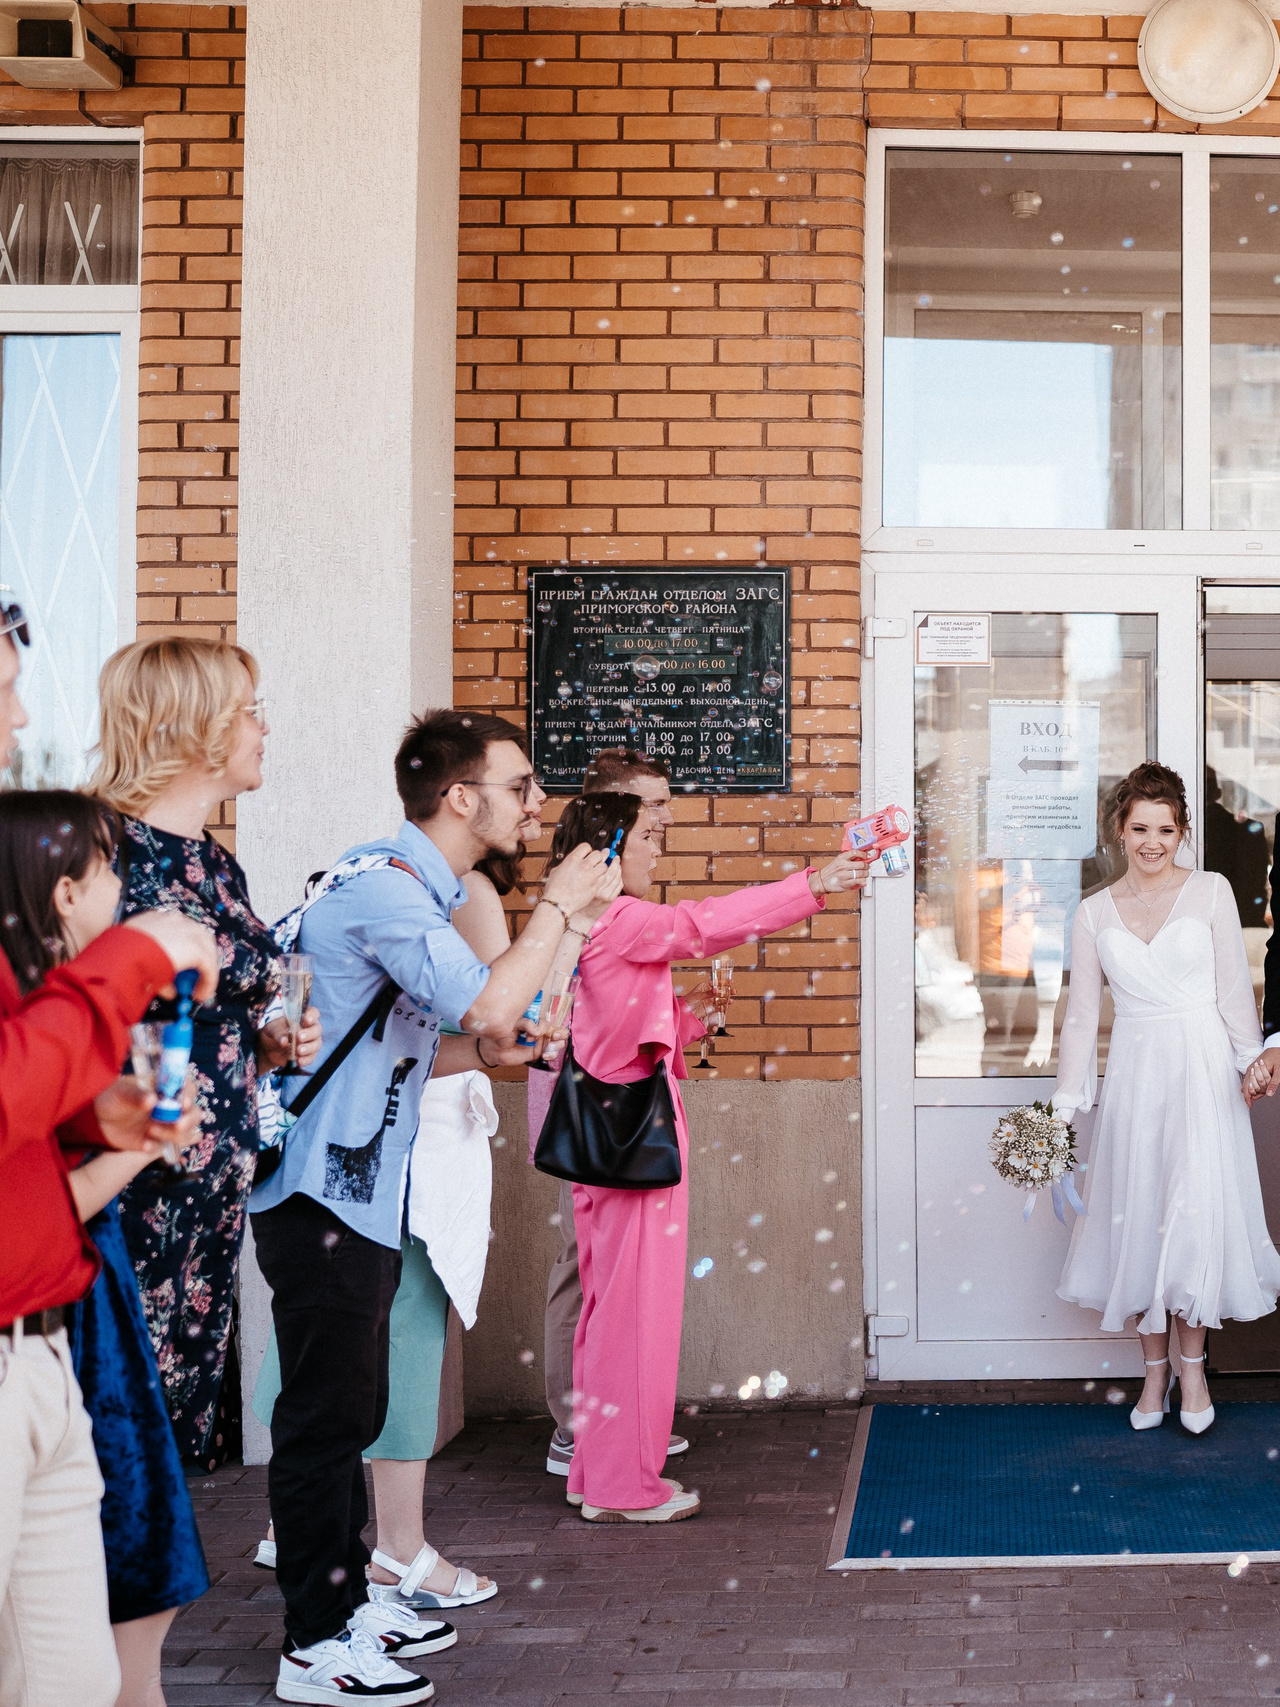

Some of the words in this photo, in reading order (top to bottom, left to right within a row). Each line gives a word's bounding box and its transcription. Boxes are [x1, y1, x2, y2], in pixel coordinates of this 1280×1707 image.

[540, 590, 585, 600] ПРИЕМ
[591, 590, 658, 601] ГРАЖДАН
[663, 590, 727, 601] ОТДЕЛОМ
[735, 587, 780, 600] ЗАГС
[581, 604, 679, 614] ПРИМОРСКОГО
[685, 602, 737, 614] РАЙОНА
[702, 626, 745, 634] ПЯТНИЦА
[672, 638, 698, 648] 17.00
[589, 663, 630, 671] СУББОТА
[698, 659, 726, 669] 16.00
[586, 685, 629, 693] ПЕРЕРЫВ
[690, 697, 741, 706] ВЫХОДНОЙ
[744, 698, 769, 706] ДЕНЬ
[545, 721, 576, 729] ПРИЕМ
[580, 721, 626, 729] ГРАЖДАН
[630, 720, 697, 729] НАЧАЛЬНИКОМ
[700, 720, 734, 729] ОТДЕЛА
[738, 717, 773, 728] ЗАГС
[1020, 721, 1072, 738] ВХОД
[586, 734, 628, 742] ВТОРНИК
[676, 765, 712, 774] РАБОЧИЙ
[741, 766, 778, 774] КВАРТАЛА
